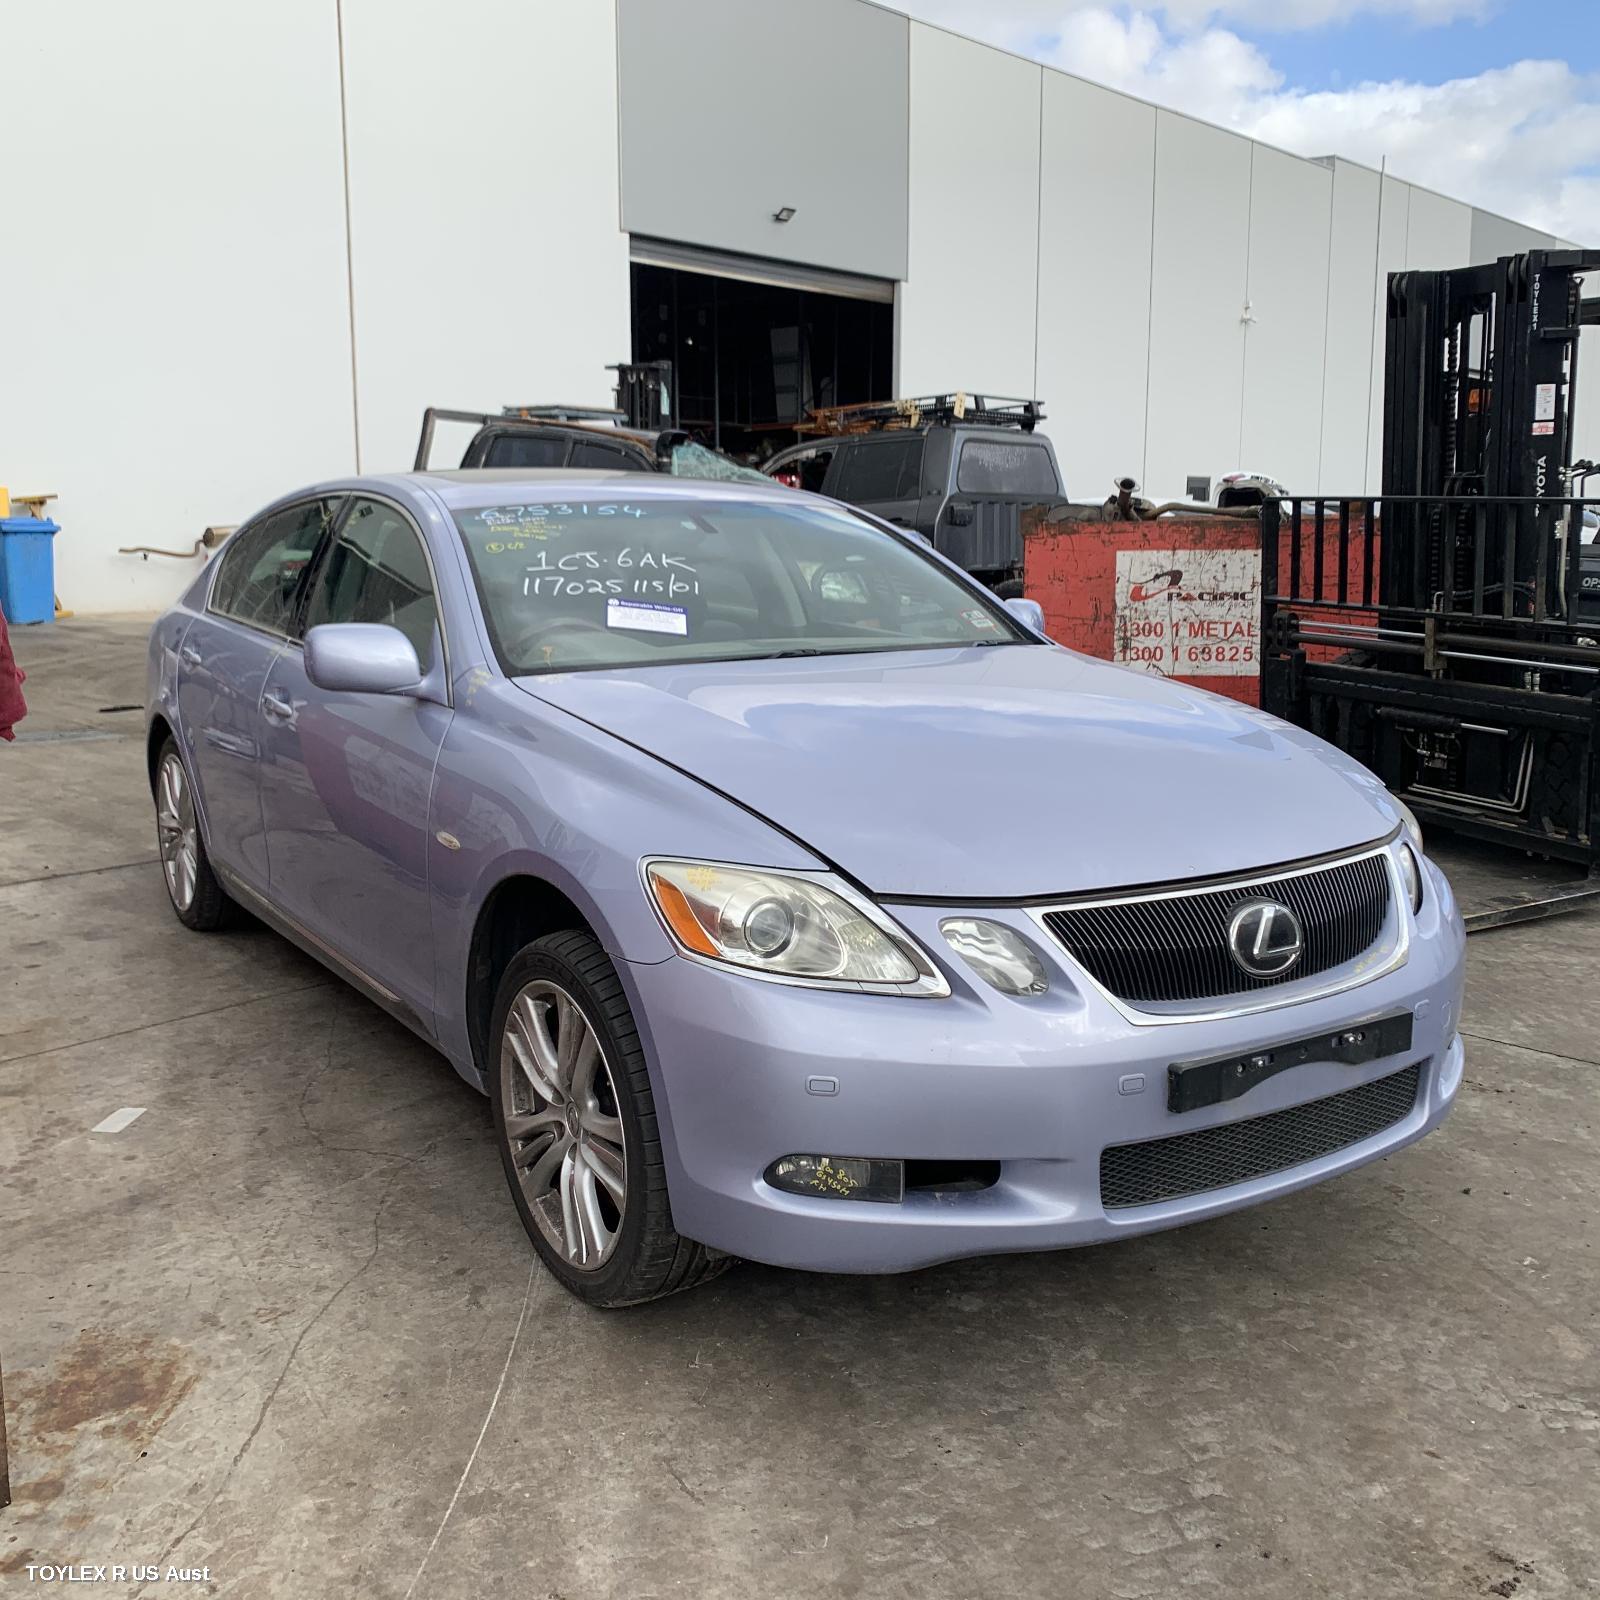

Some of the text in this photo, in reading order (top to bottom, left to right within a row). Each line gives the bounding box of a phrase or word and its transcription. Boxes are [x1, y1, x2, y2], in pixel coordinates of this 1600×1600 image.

[480, 504, 648, 520] 6753154
[523, 576, 624, 597] 117025
[1120, 620, 1258, 637] 1300 1 METAL
[1120, 645, 1254, 661] 1300 1 63825
